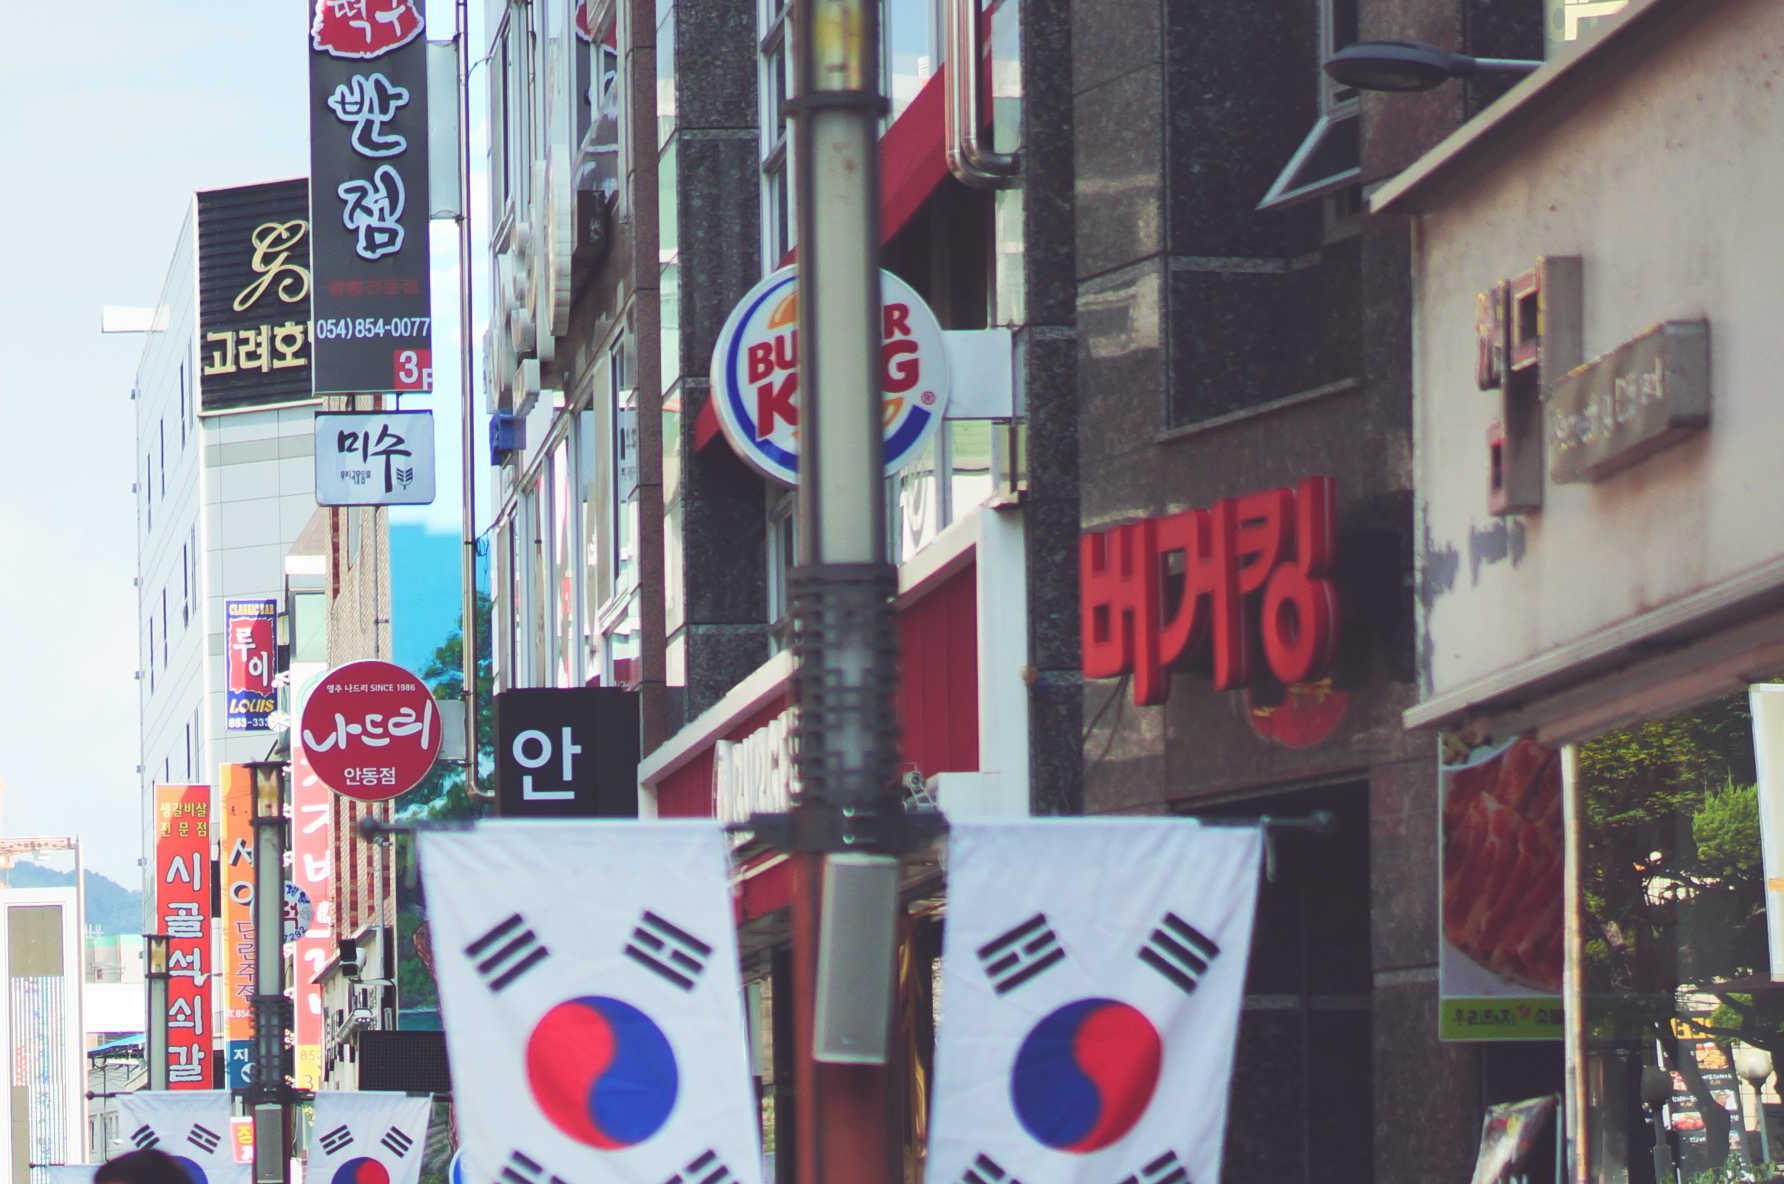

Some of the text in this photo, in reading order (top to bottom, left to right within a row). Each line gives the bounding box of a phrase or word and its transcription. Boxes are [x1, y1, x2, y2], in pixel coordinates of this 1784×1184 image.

[747, 303, 912, 385] BUR
[757, 339, 920, 439] KG
[337, 423, 413, 494] 미수
[1080, 475, 1336, 707] 버거킹
[232, 626, 270, 688] 루이
[229, 698, 275, 714] LOUIS
[370, 684, 394, 693] SINCE
[302, 699, 433, 753] 나드리
[343, 766, 397, 786] 안동점
